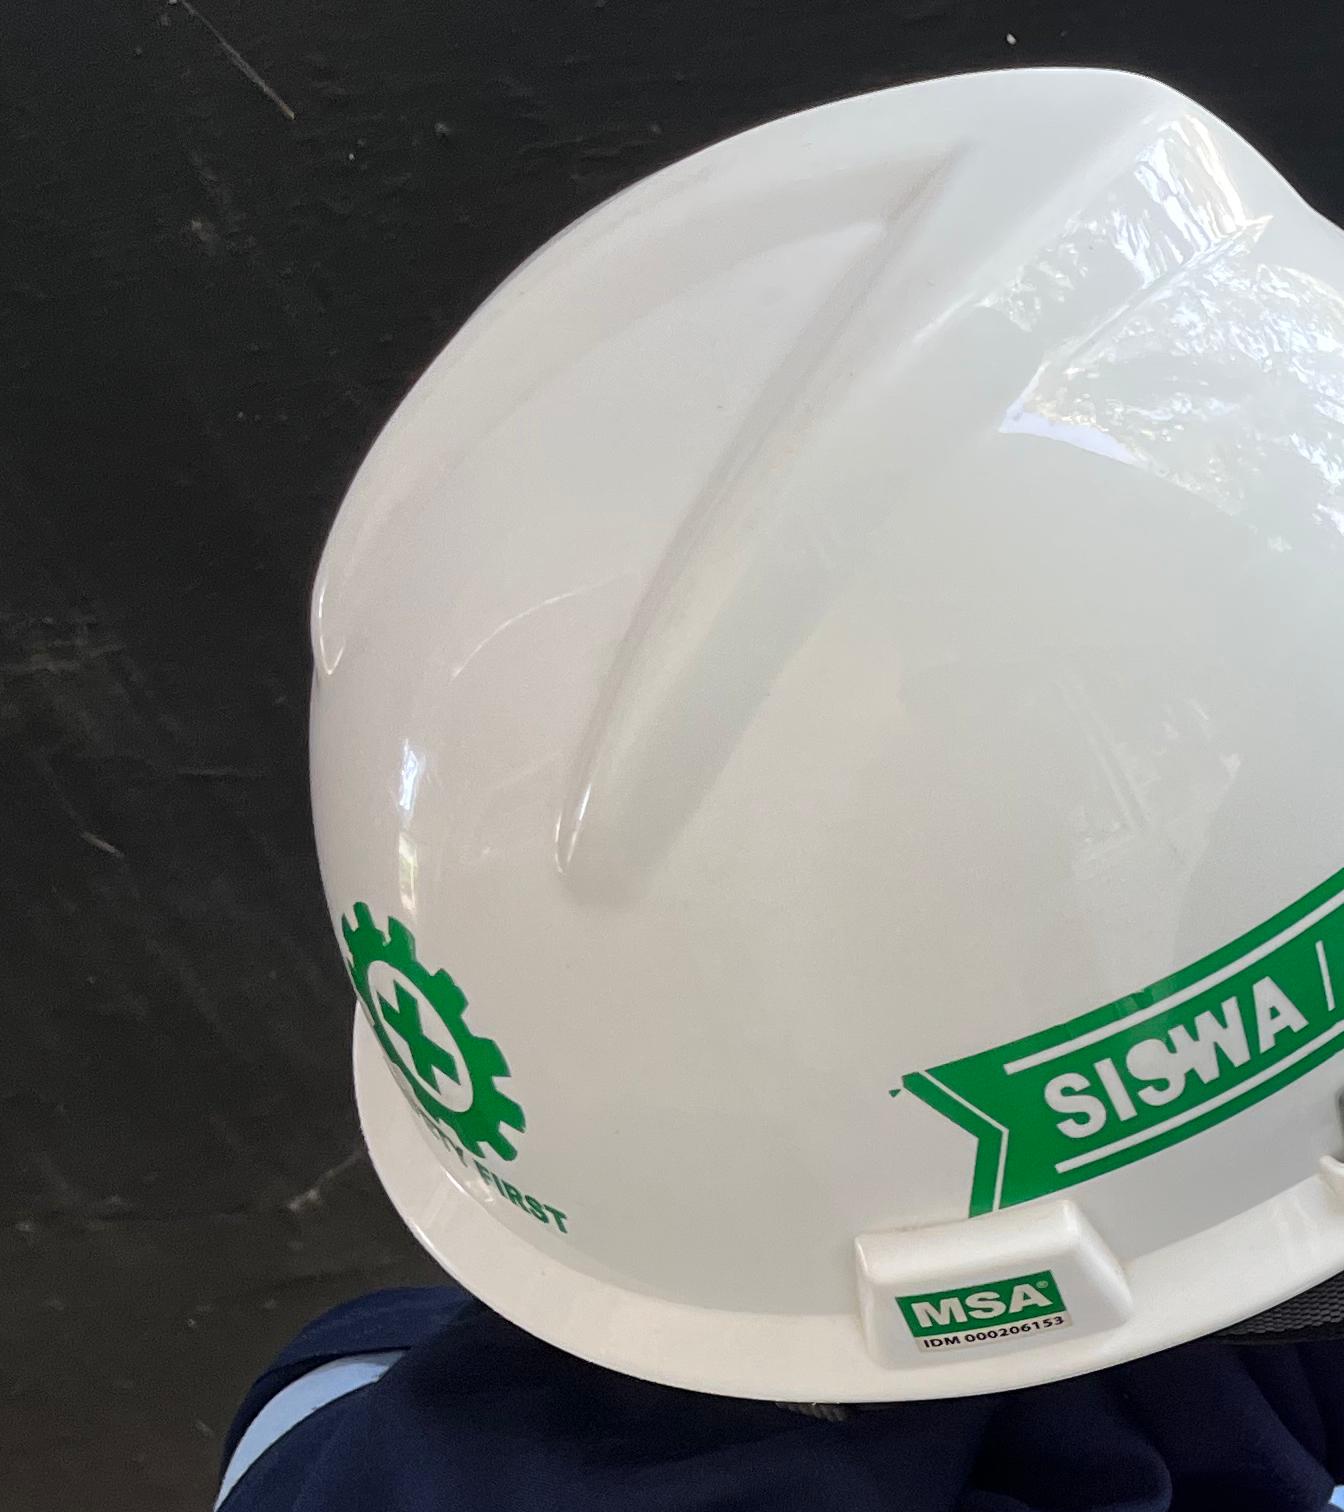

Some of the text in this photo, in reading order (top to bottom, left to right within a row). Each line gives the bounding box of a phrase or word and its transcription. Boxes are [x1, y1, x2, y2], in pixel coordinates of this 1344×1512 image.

[1044, 976, 1308, 1138] SISWA
[1316, 941, 1335, 1011] /
[474, 1158, 567, 1233] FIRST
[911, 1283, 1053, 1328] MSA
[924, 1315, 1065, 1349] IDM 000206153
